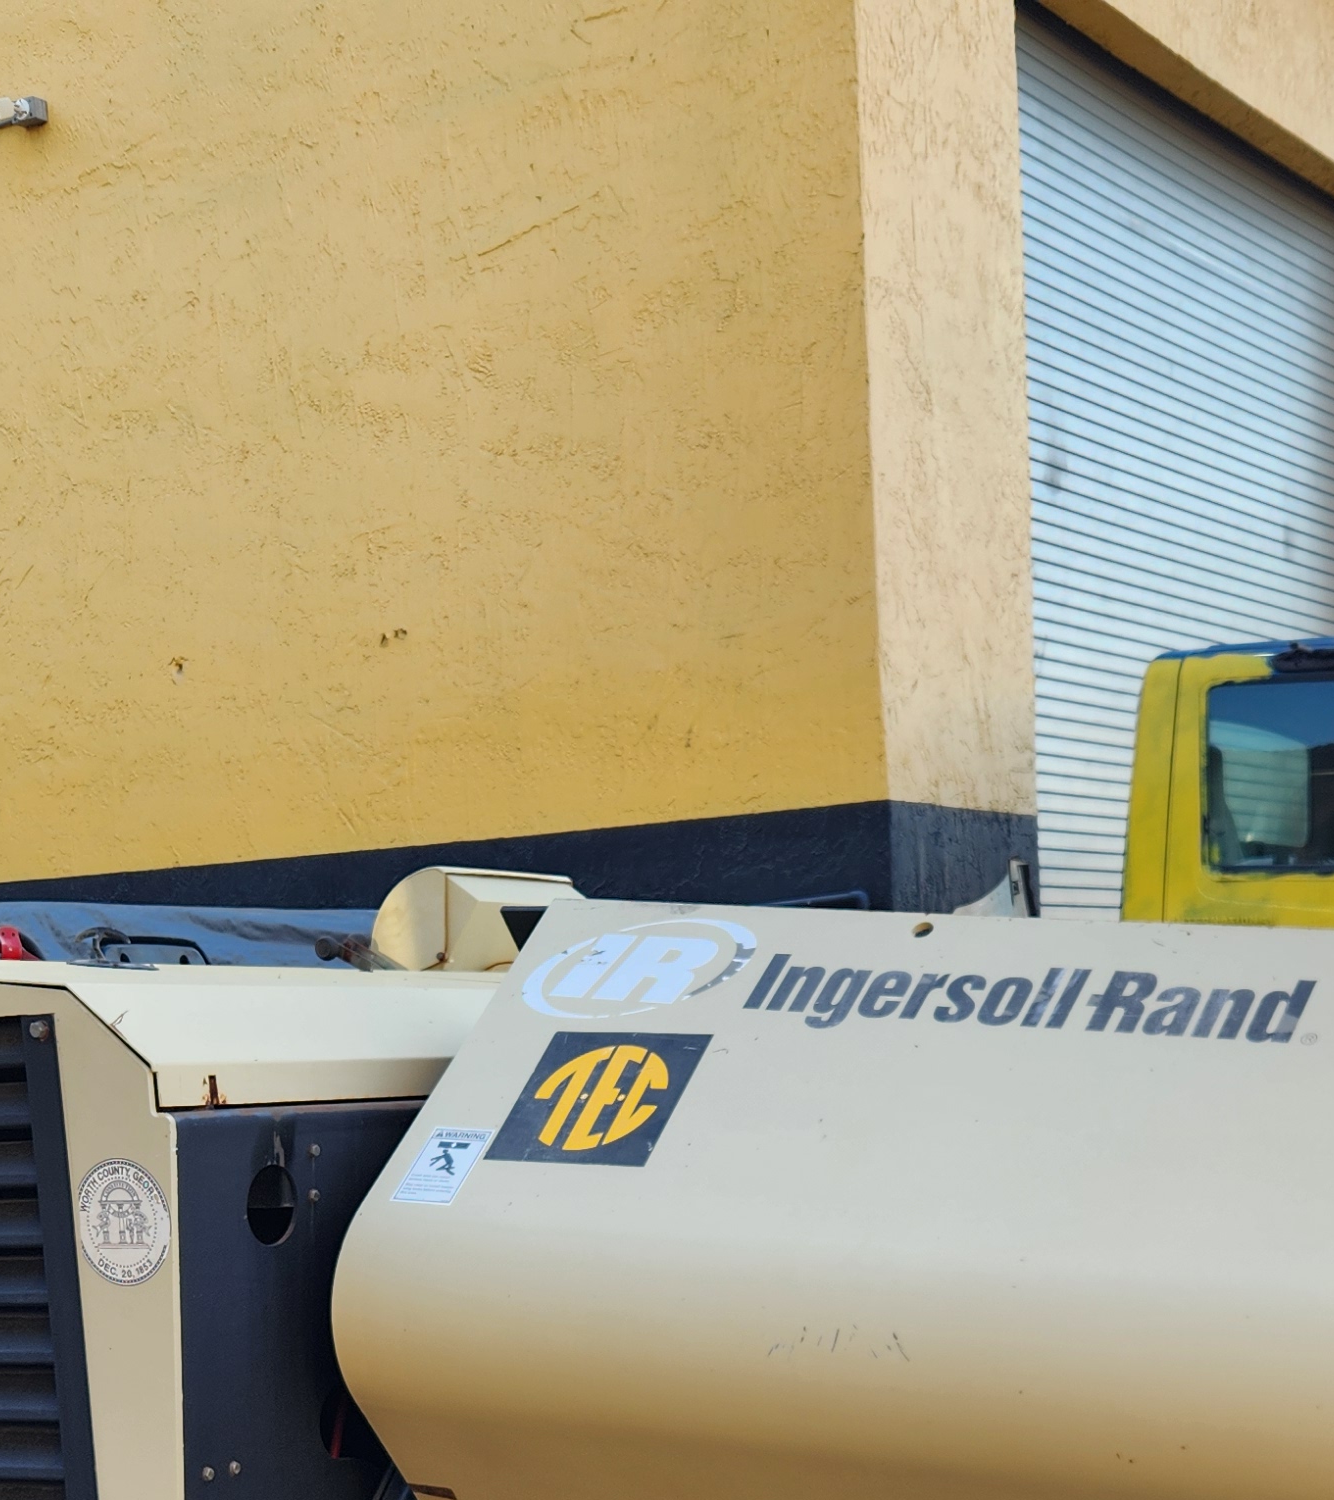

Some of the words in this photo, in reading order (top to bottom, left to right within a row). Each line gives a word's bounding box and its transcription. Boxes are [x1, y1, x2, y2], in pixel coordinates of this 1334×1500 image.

[444, 1131, 487, 1140] WARNING
[79, 1177, 99, 1212] WORTH
[97, 1258, 119, 1277] DEC.
